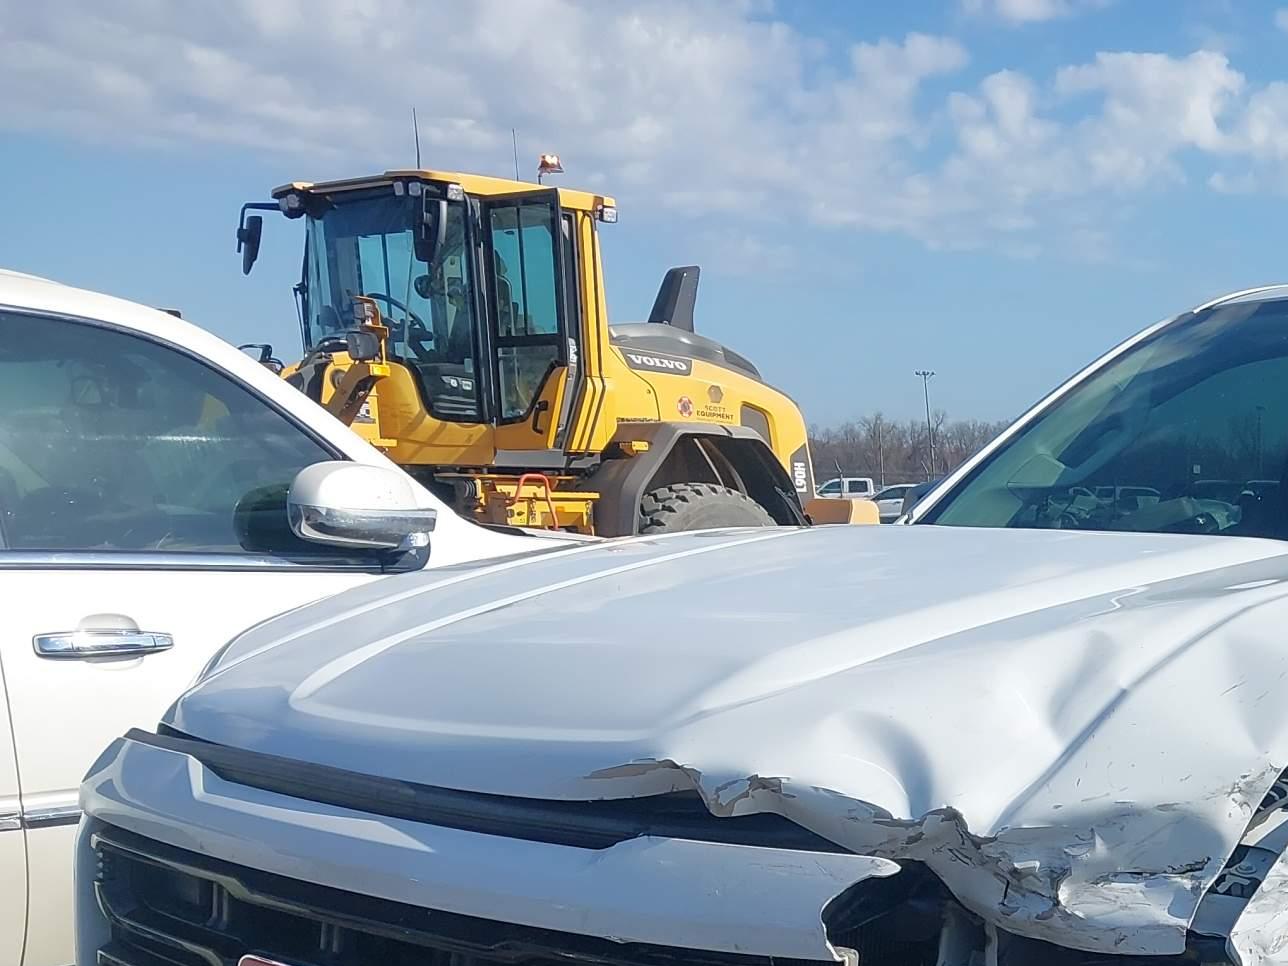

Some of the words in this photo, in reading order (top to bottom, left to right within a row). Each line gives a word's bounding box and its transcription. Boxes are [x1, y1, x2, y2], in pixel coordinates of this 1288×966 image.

[627, 353, 687, 371] VOLVO
[696, 409, 734, 421] EQUIPMENT
[704, 405, 726, 413] SCOTT
[793, 462, 808, 493] L90H
